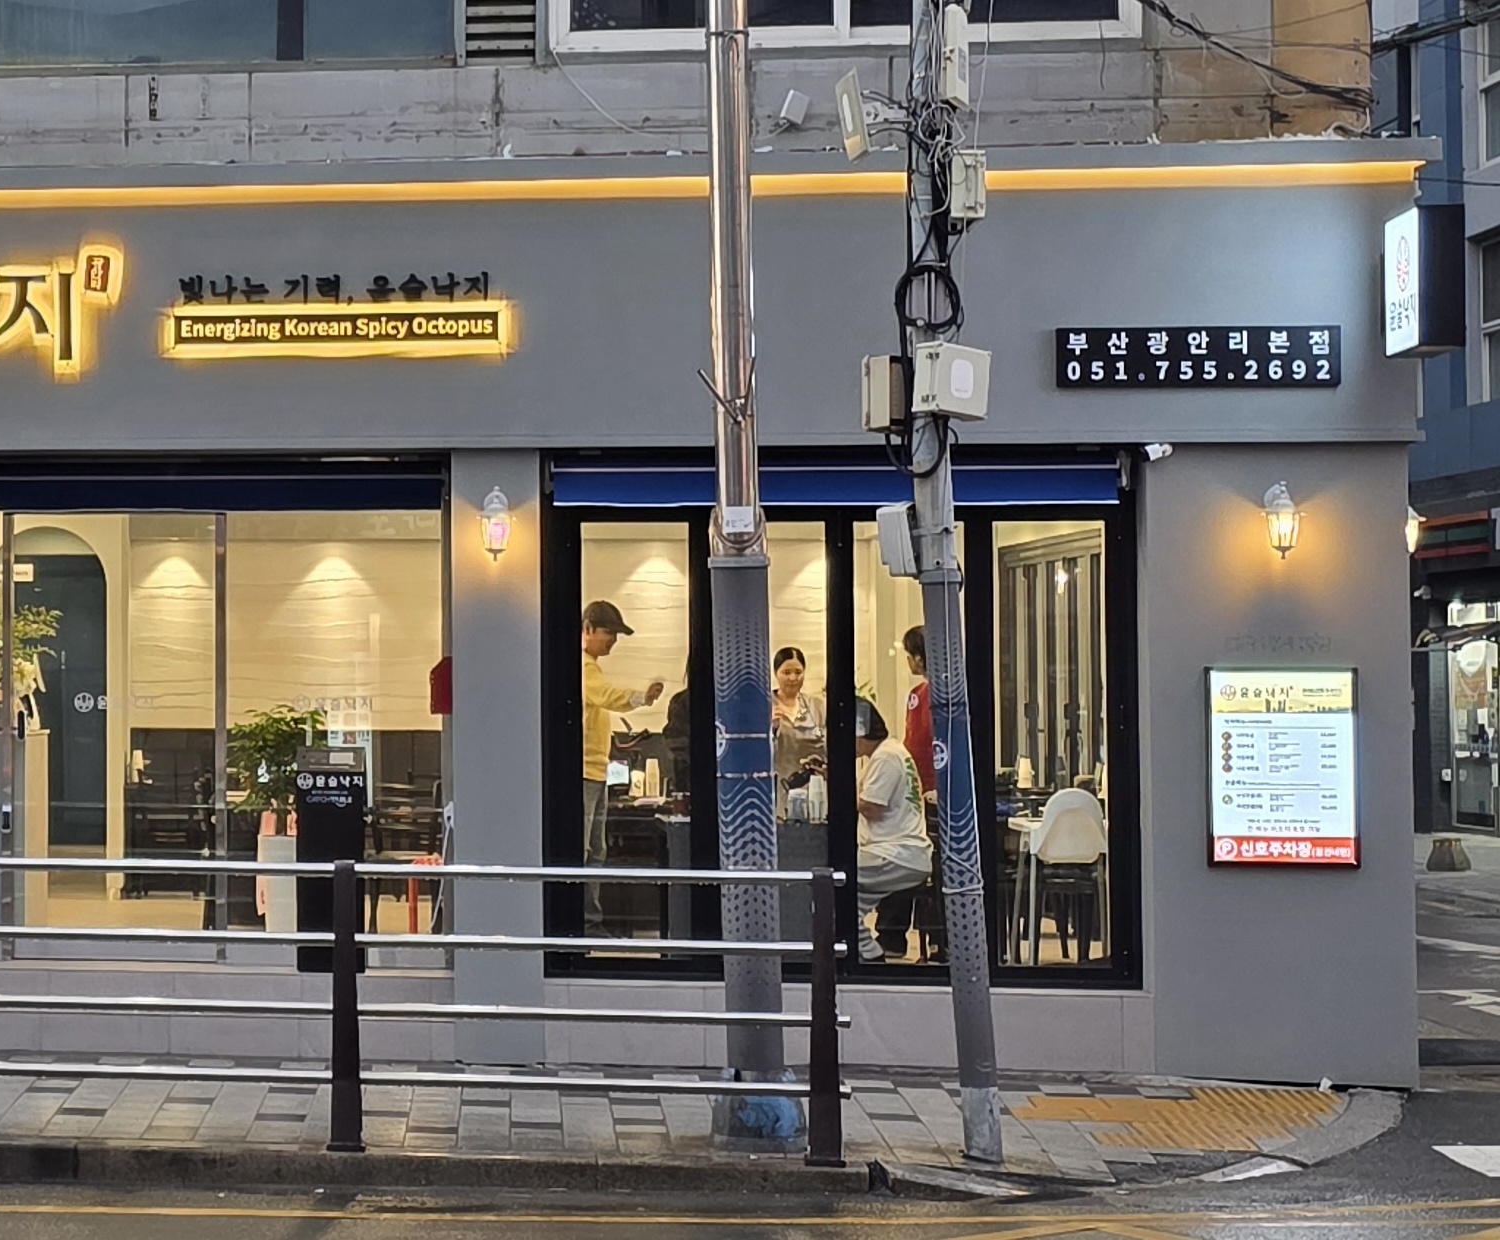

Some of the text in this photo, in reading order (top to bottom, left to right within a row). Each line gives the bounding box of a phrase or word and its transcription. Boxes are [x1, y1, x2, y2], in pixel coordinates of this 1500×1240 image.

[179, 274, 270, 304] 빛나는
[180, 316, 493, 341] Energizing Korean Spicy Octopus
[1066, 330, 1331, 356] 부산광안리본점
[1066, 361, 1331, 381] 051.755.2692
